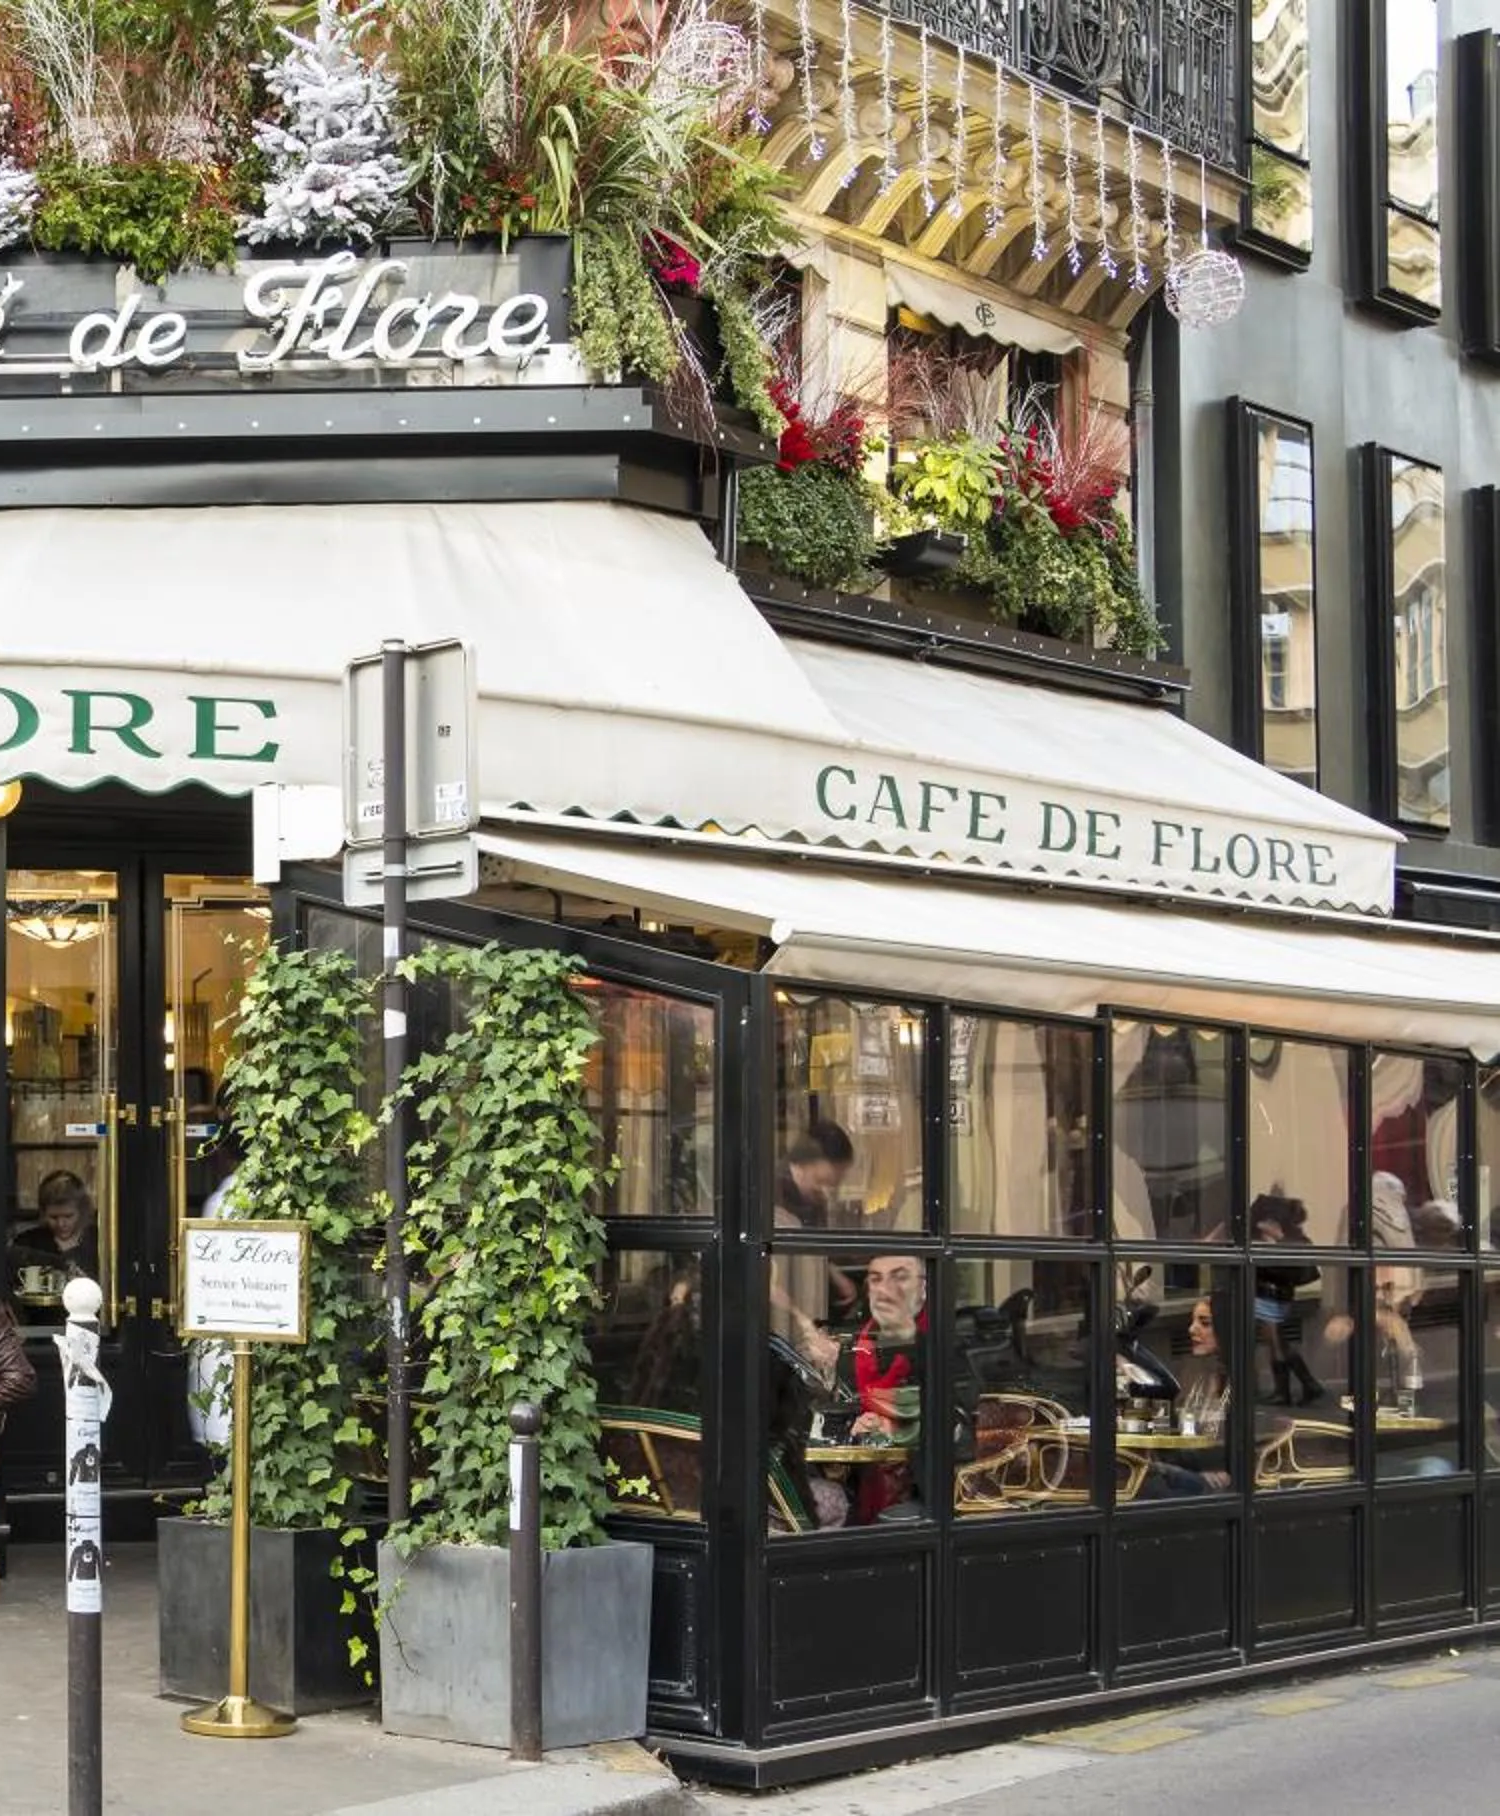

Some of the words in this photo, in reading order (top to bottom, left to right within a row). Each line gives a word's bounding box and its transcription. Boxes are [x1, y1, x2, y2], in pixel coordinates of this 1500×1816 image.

[68, 294, 187, 367] de
[238, 251, 550, 366] Flore
[815, 765, 1008, 843] CAFE
[1038, 800, 1122, 860] DE
[1151, 819, 1338, 887] FLORE
[194, 1233, 222, 1263] Le
[229, 1236, 295, 1265] Flore
